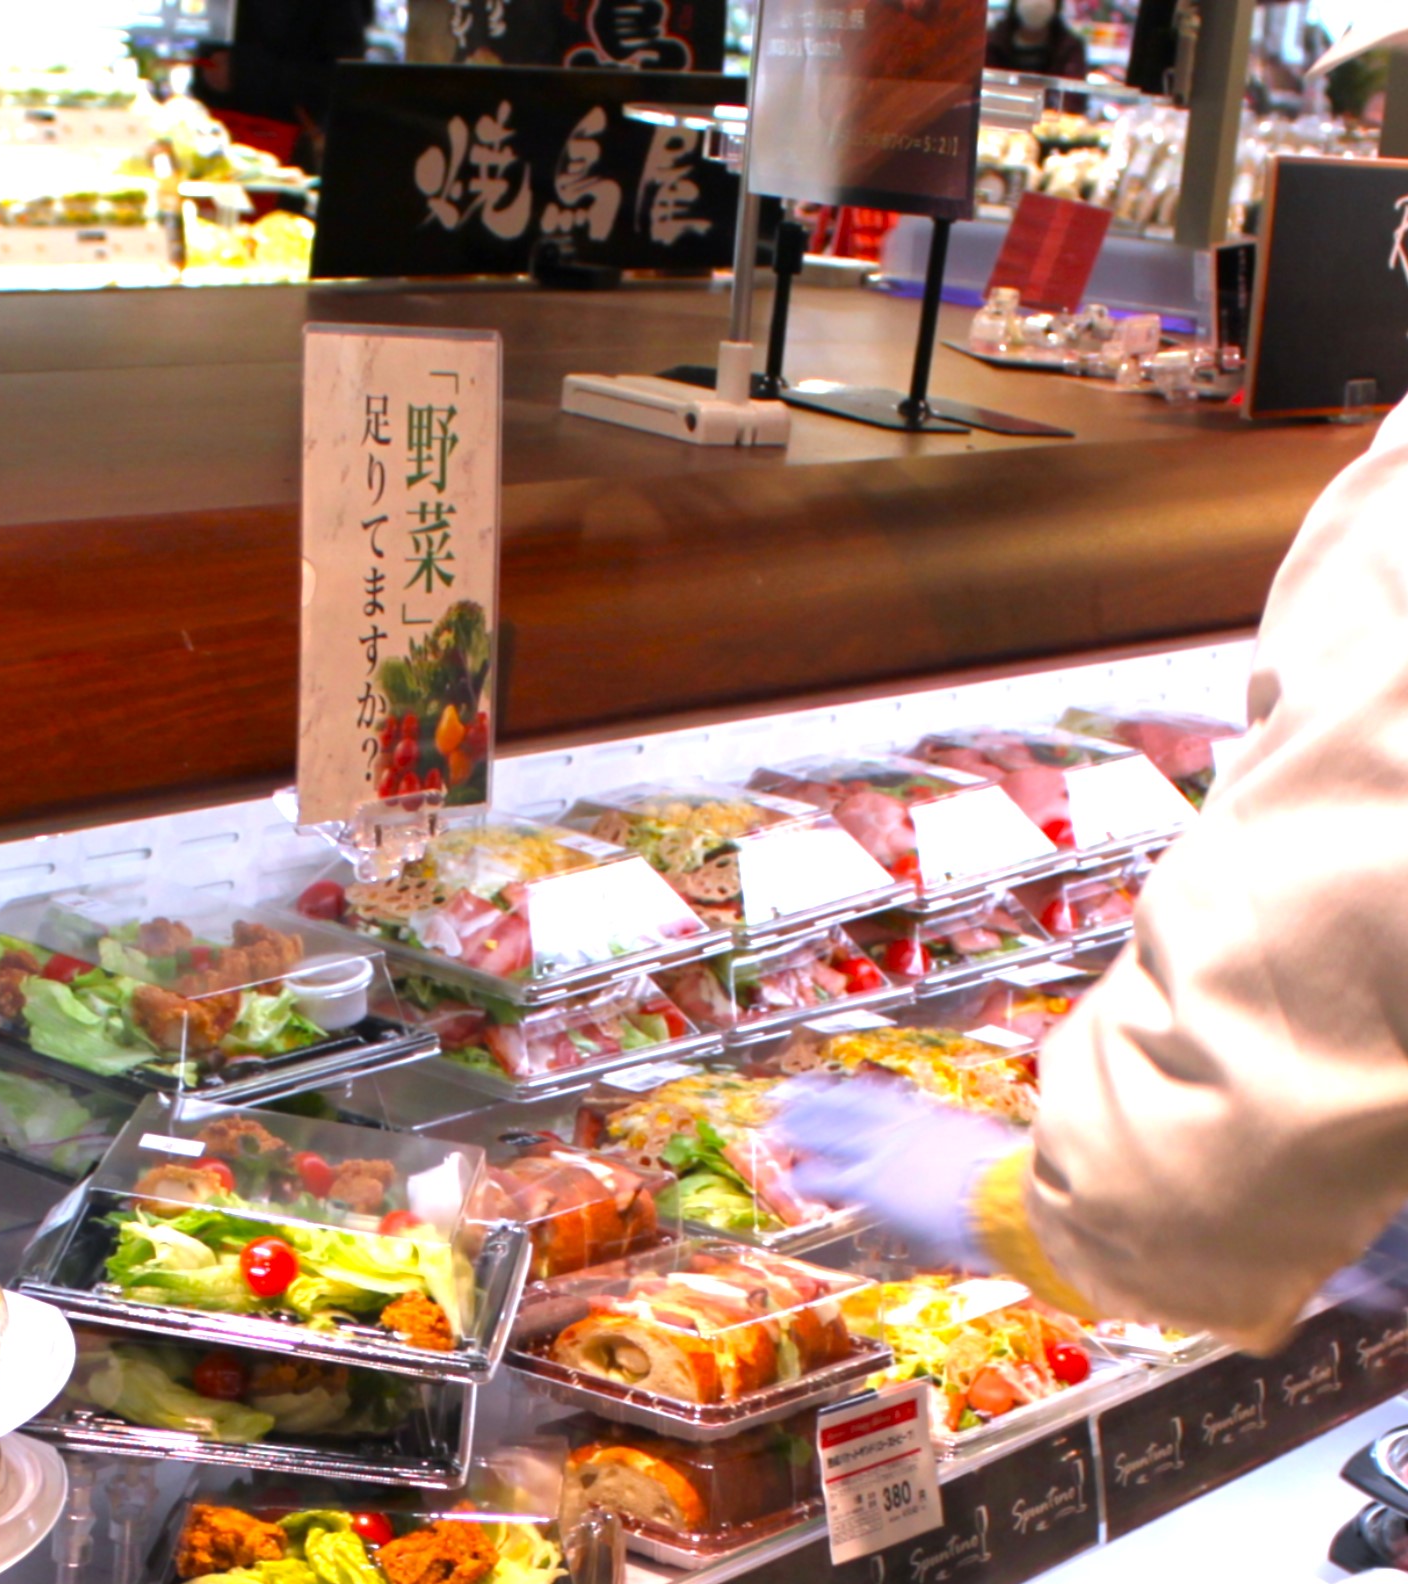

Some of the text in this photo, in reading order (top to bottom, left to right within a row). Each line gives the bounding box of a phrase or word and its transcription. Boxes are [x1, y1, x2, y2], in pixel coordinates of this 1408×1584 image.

[414, 100, 712, 246] 焼鳥屋
[402, 371, 460, 624] 「野菜」
[883, 1480, 912, 1513] 380
